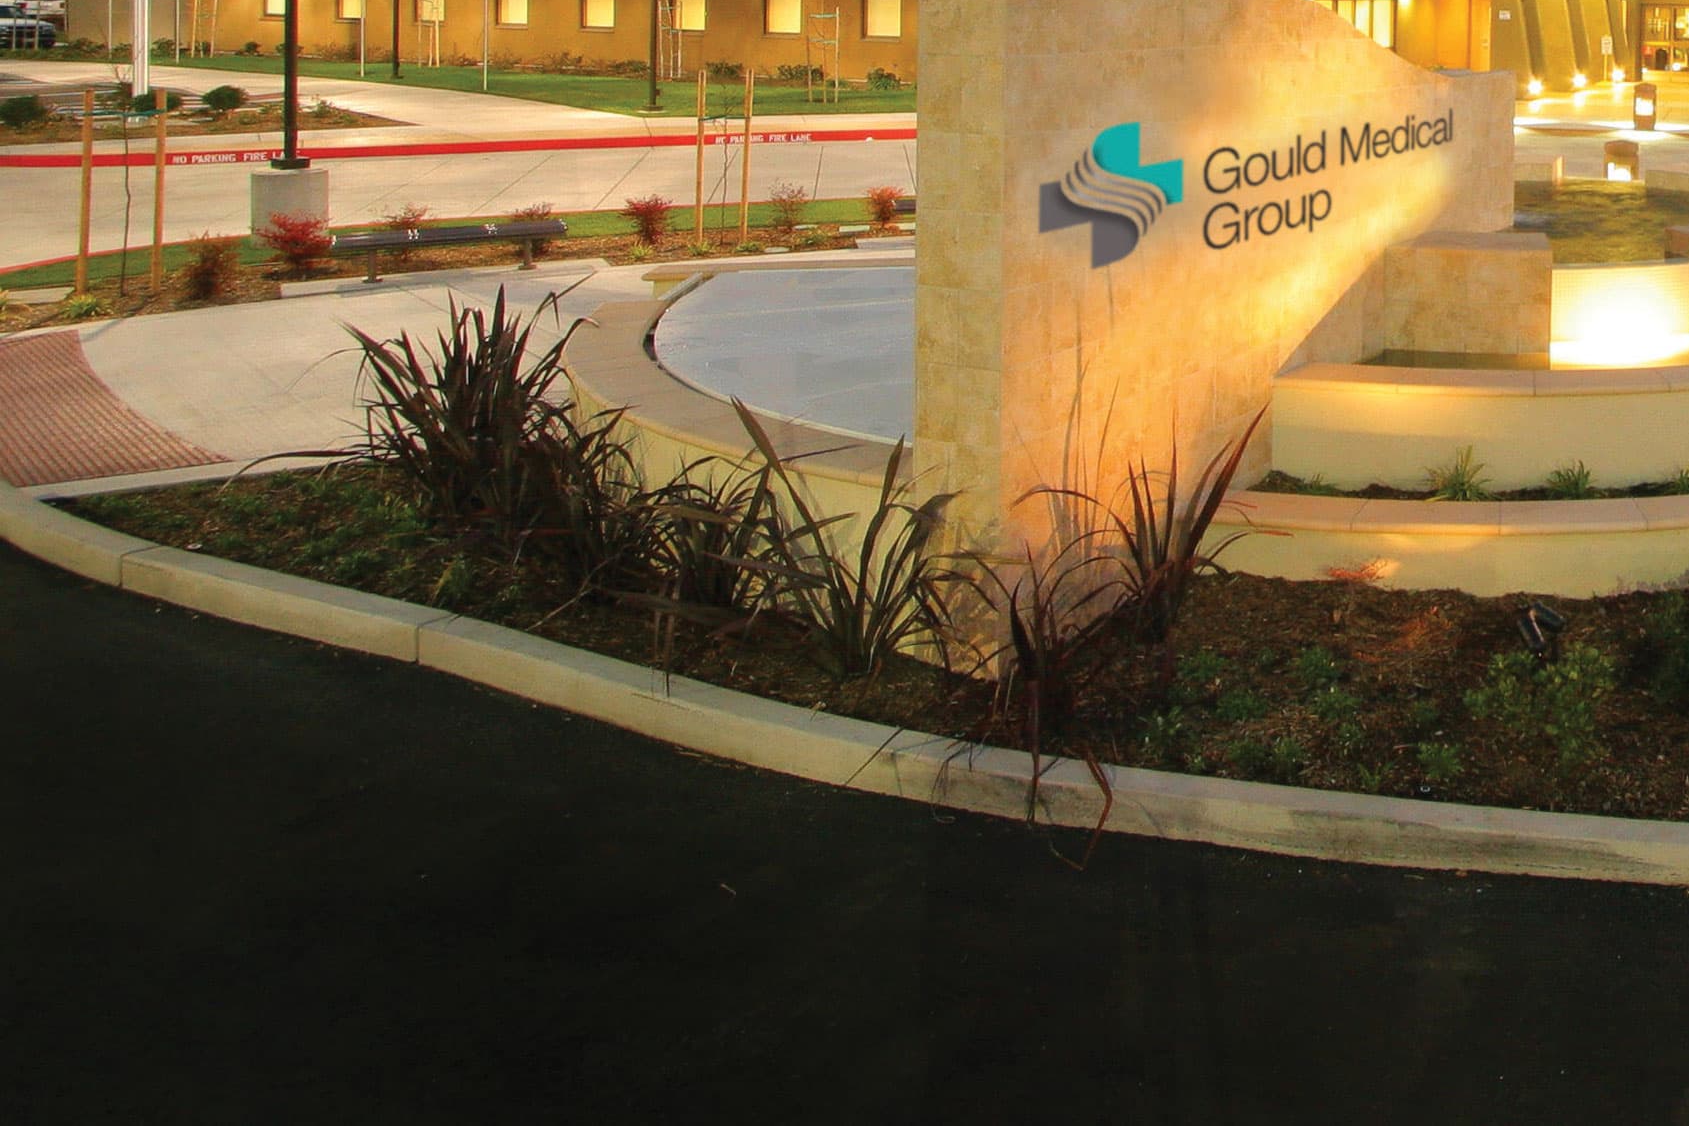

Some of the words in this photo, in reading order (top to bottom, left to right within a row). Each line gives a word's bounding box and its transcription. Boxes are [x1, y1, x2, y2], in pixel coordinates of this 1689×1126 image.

[172, 154, 187, 164] NO
[191, 153, 236, 164] PARKING
[243, 151, 268, 162] FIRE
[1203, 130, 1326, 194] Gould
[1339, 108, 1453, 166] Medical
[1203, 188, 1332, 249] Group
